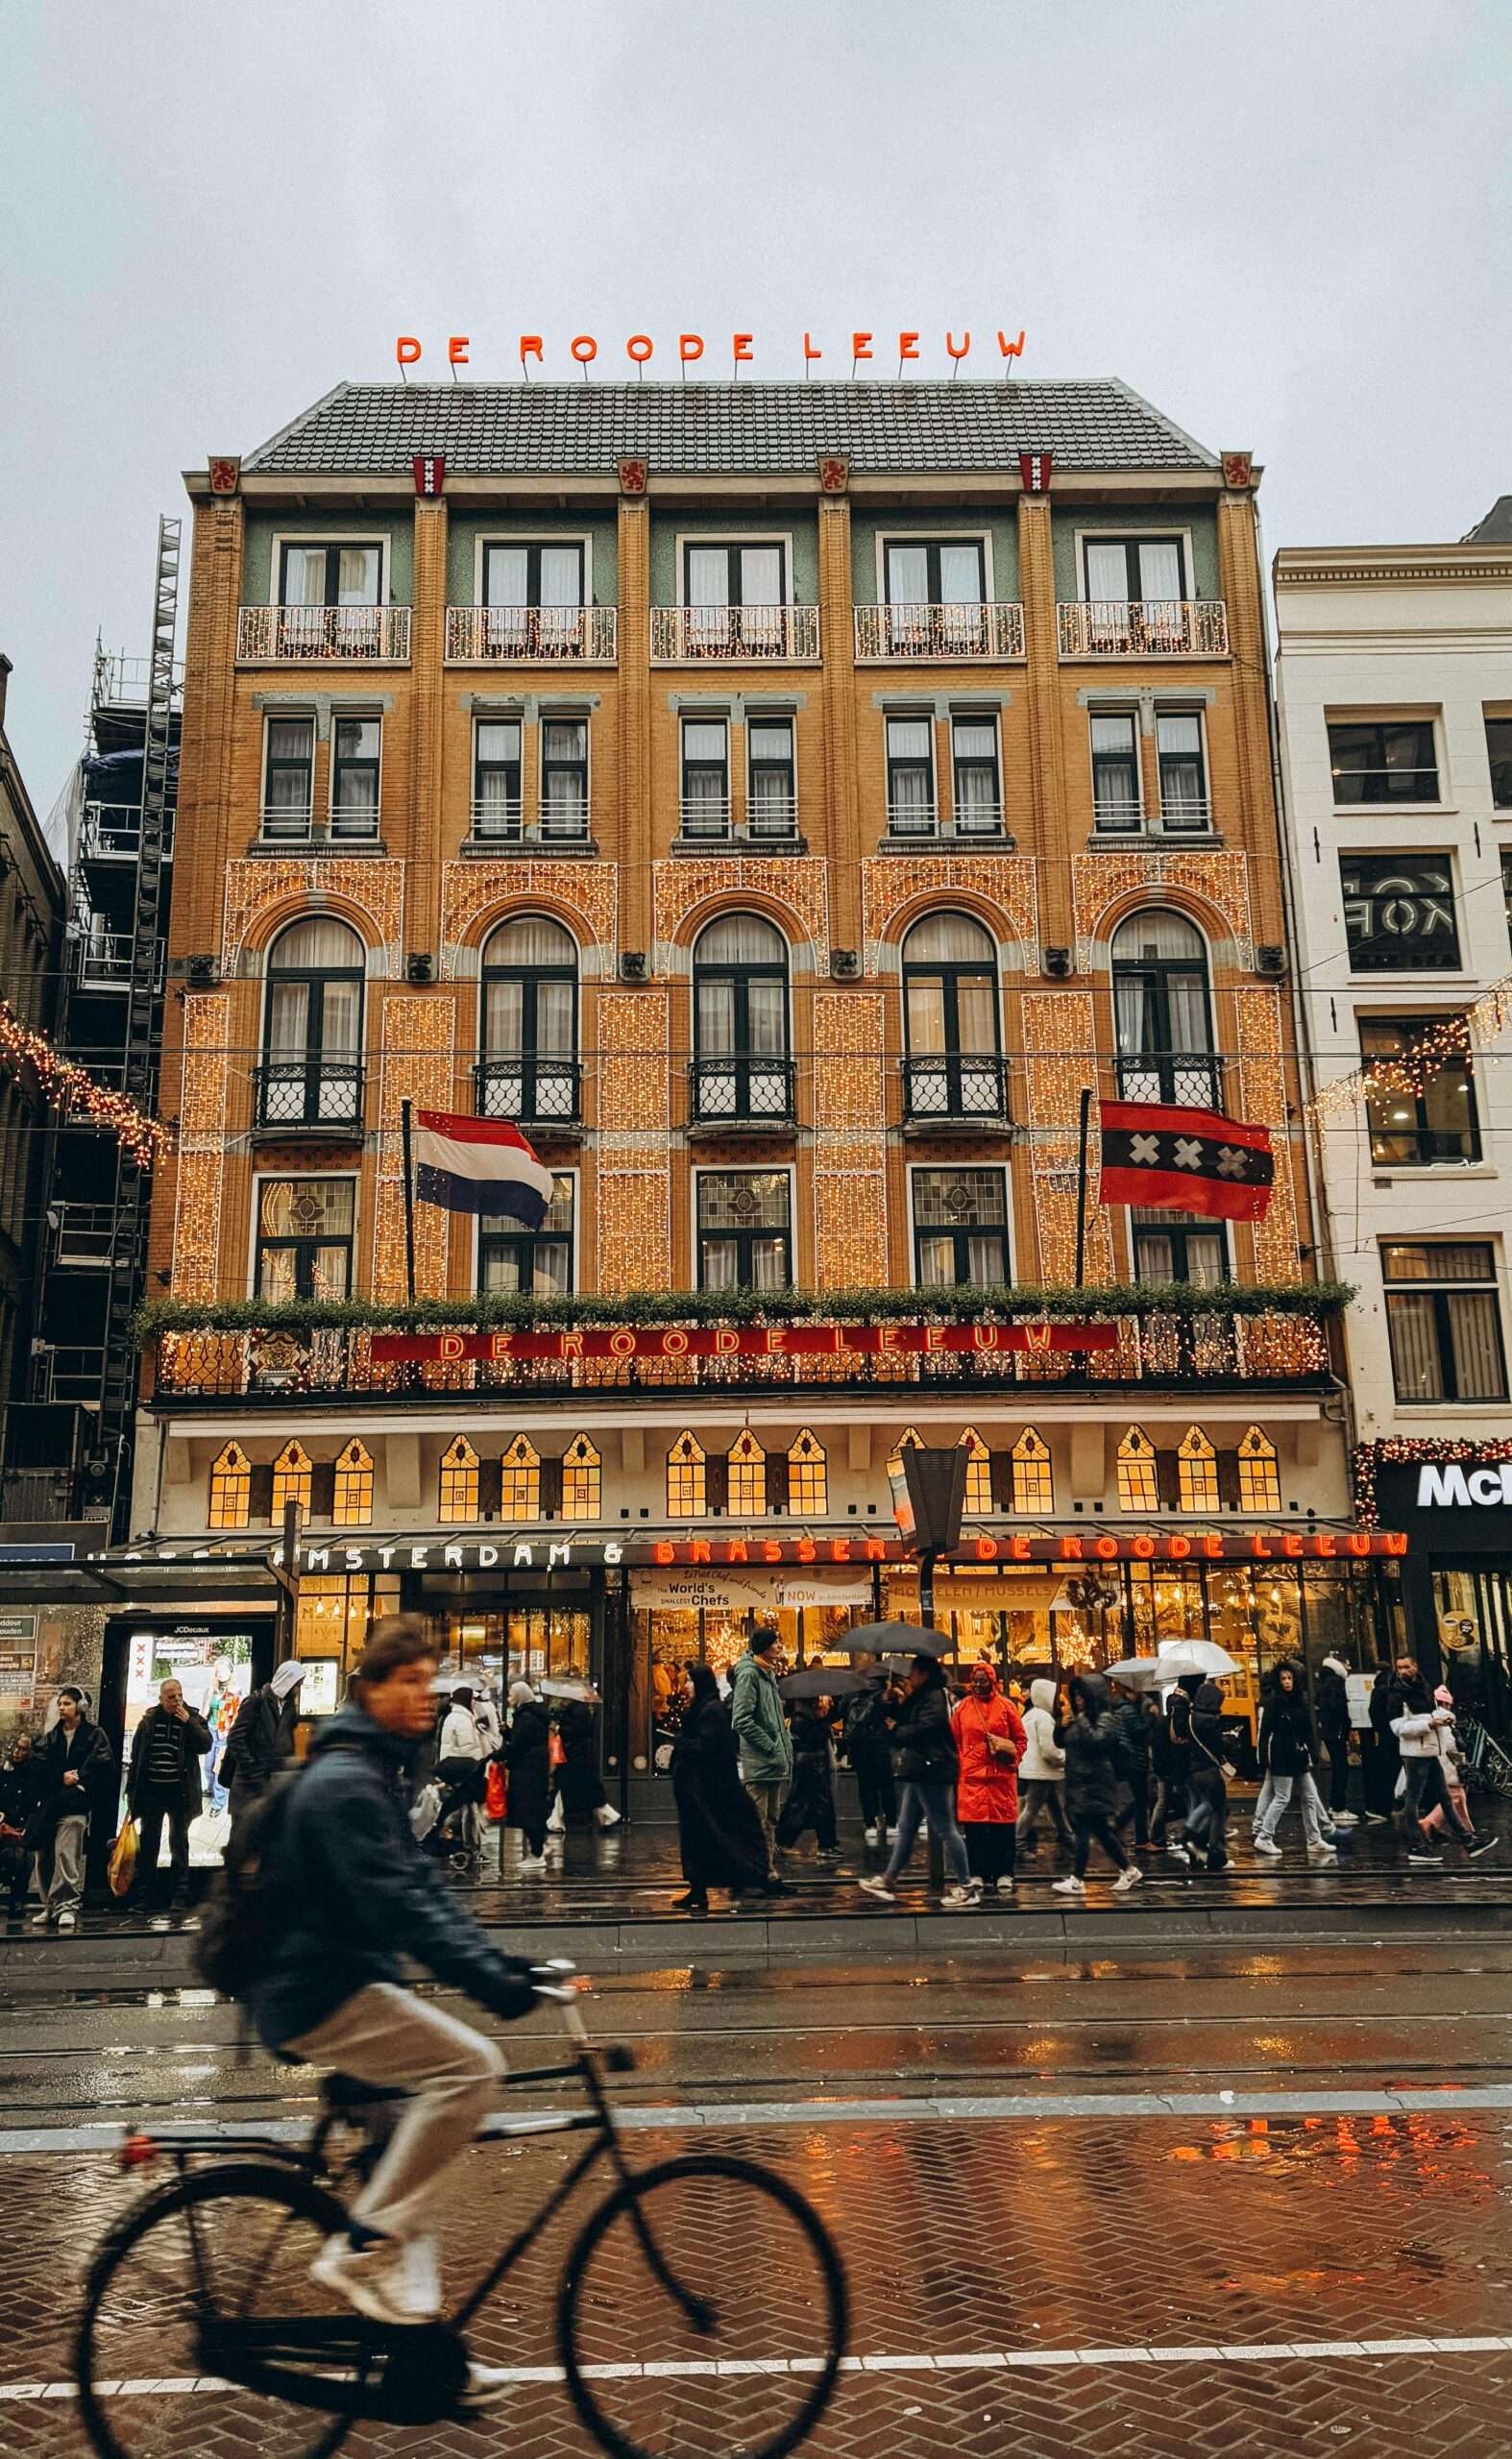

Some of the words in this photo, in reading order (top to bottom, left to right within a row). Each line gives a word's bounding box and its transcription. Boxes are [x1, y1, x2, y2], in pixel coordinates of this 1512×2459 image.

[397, 336, 470, 364] DE
[520, 333, 754, 362] ROODE
[804, 330, 1026, 359] LEEUW
[440, 1334, 513, 1360] DE
[561, 1330, 787, 1356] ROODE
[835, 1326, 1052, 1352] LEEUW
[603, 1543, 623, 1564] &
[655, 1537, 945, 1563] BRASSER
[974, 1536, 1031, 1560] DE
[1060, 1534, 1225, 1558] ROODE
[1250, 1533, 1407, 1556] LEEUW
[669, 1582, 716, 1595] World's
[894, 1586, 972, 1597] MOELEN
[984, 1585, 1052, 1597] MUSSELS
[692, 1594, 730, 1606] Chefs
[787, 1590, 816, 1602] NOW
[174, 1625, 209, 1634] JCDecaux
